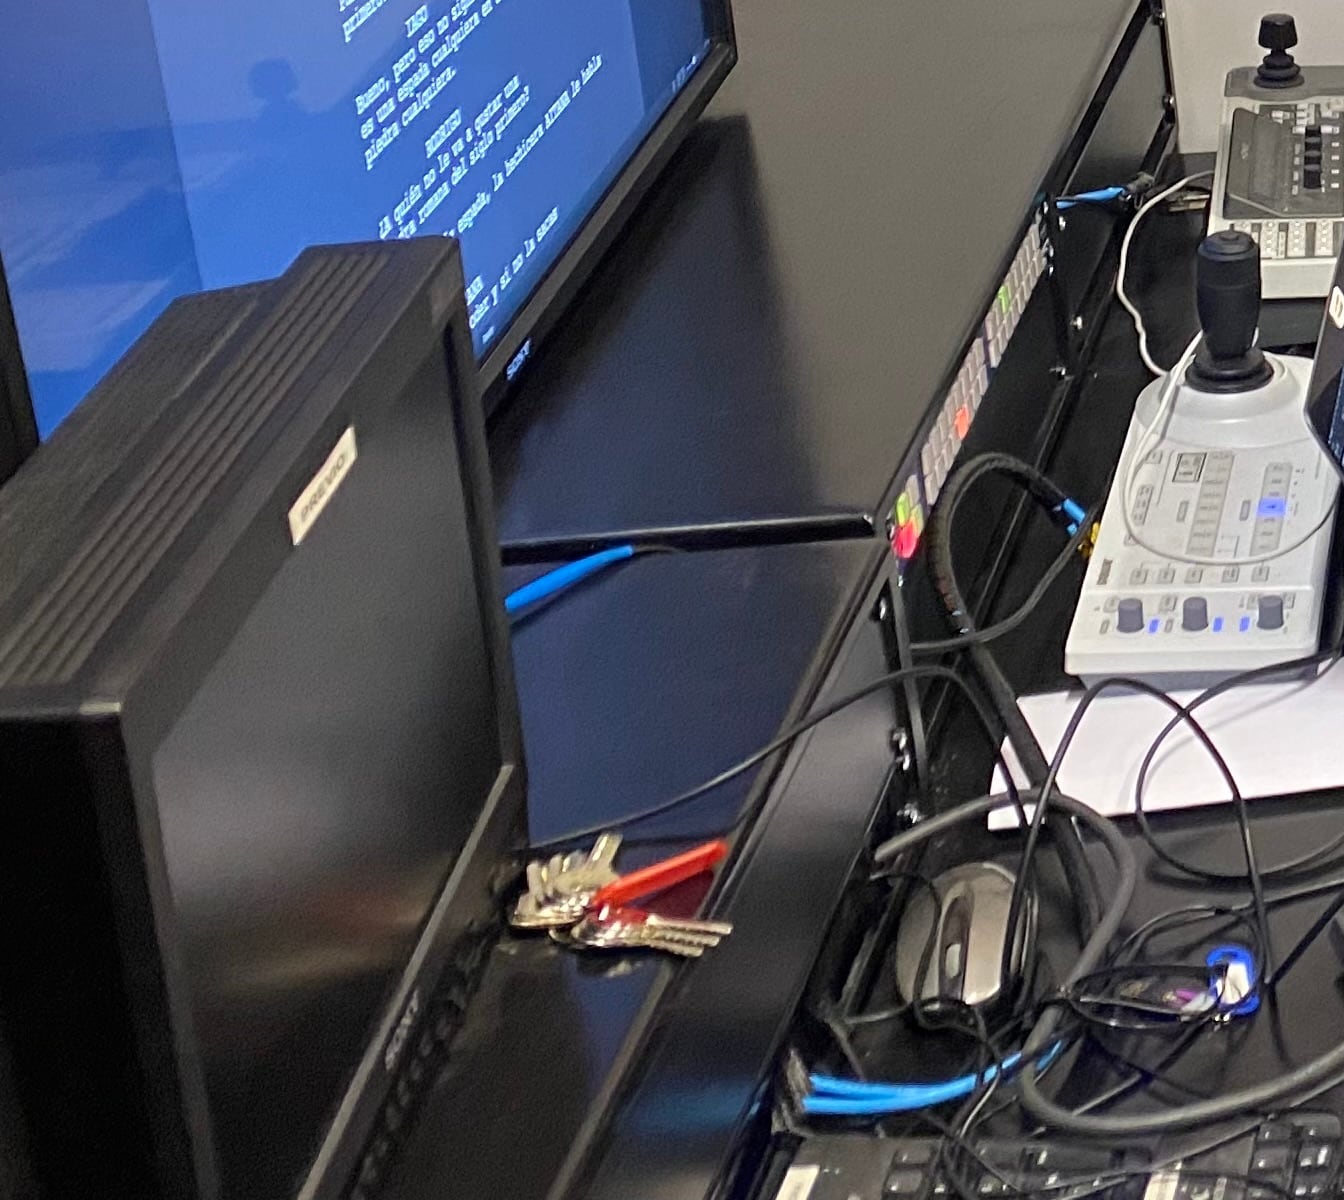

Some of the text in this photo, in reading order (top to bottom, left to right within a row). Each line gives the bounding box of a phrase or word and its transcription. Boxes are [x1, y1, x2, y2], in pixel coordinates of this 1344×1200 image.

[356, 77, 390, 115] Bueno,
[392, 48, 416, 84] pero
[418, 29, 436, 54] eso
[437, 16, 449, 36] no
[361, 118, 374, 140] es
[376, 98, 396, 124] una
[398, 63, 430, 102] espada
[432, 12, 480, 68] cualquiera
[481, 0, 493, 18] en
[365, 66, 456, 171] piedra cualquiera.
[394, 184, 422, 225] quién
[423, 168, 436, 190] no
[438, 153, 450, 174] le
[452, 138, 465, 156] va
[466, 128, 474, 142] a
[474, 93, 502, 135] gustar
[504, 75, 520, 98] una
[418, 181, 450, 224] romana
[452, 161, 468, 186] del
[470, 132, 494, 165] siglo
[495, 86, 530, 141] primero?
[457, 192, 491, 233] espada,
[492, 172, 504, 192] la
[504, 124, 544, 176] hechicera
[570, 80, 581, 98] le
[581, 54, 602, 85] habla
[469, 296, 490, 329] oder
[490, 284, 498, 306] y
[500, 264, 511, 290] si
[512, 253, 524, 274] no
[524, 238, 536, 258] la
[536, 206, 558, 242] sacas
